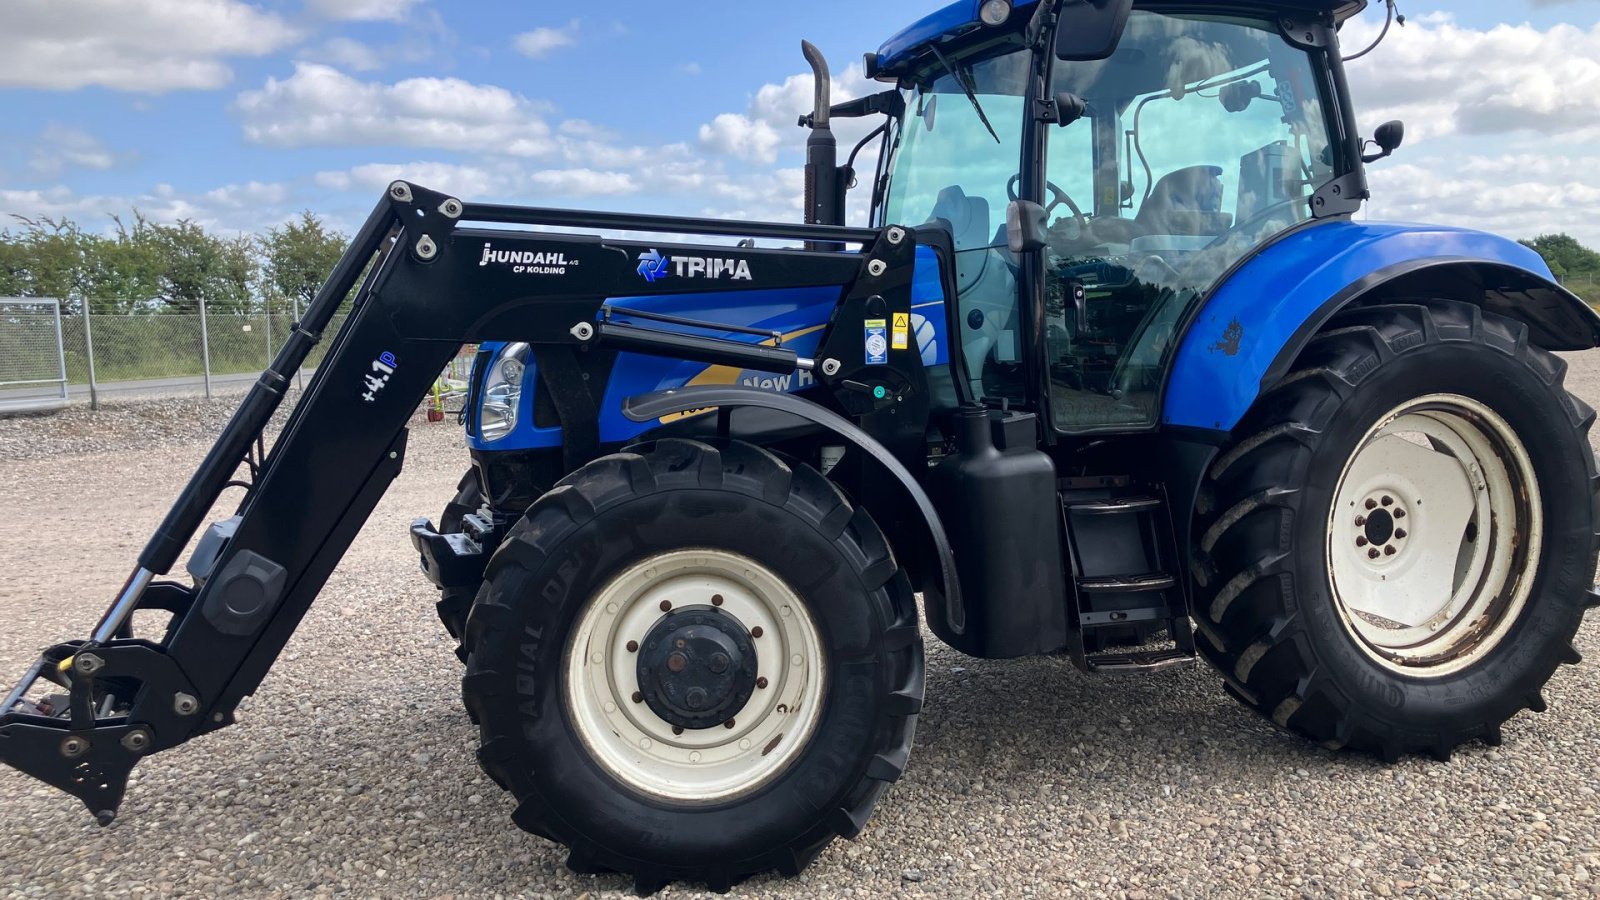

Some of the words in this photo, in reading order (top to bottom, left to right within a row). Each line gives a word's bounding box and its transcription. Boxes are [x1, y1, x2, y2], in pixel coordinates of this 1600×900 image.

[513, 265, 526, 273] CP
[527, 266, 566, 275] KOLDING
[671, 255, 753, 280] TRIMA
[516, 623, 544, 719] ADIAL
